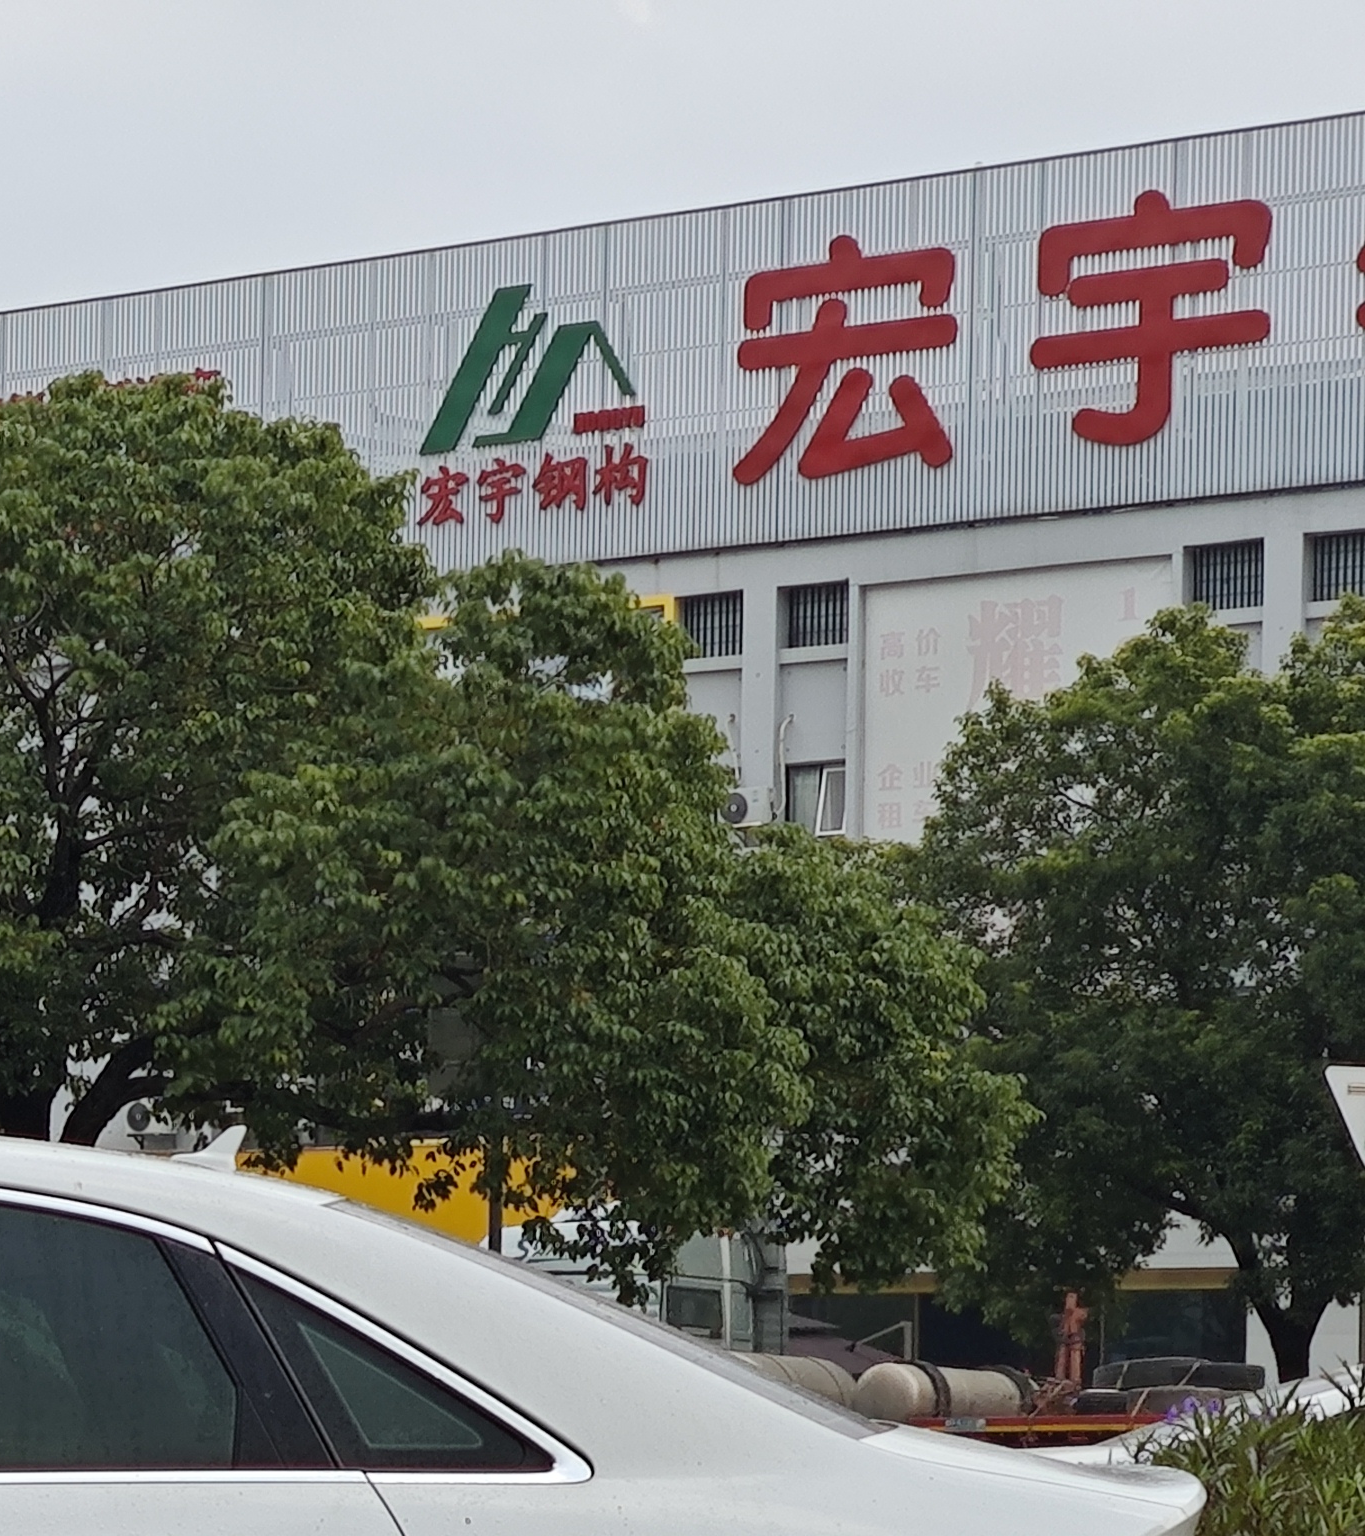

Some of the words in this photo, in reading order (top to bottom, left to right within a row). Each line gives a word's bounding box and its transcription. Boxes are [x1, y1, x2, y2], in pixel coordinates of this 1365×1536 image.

[733, 190, 1365, 486] 宏宇
[417, 443, 648, 526] 宏宇钢构
